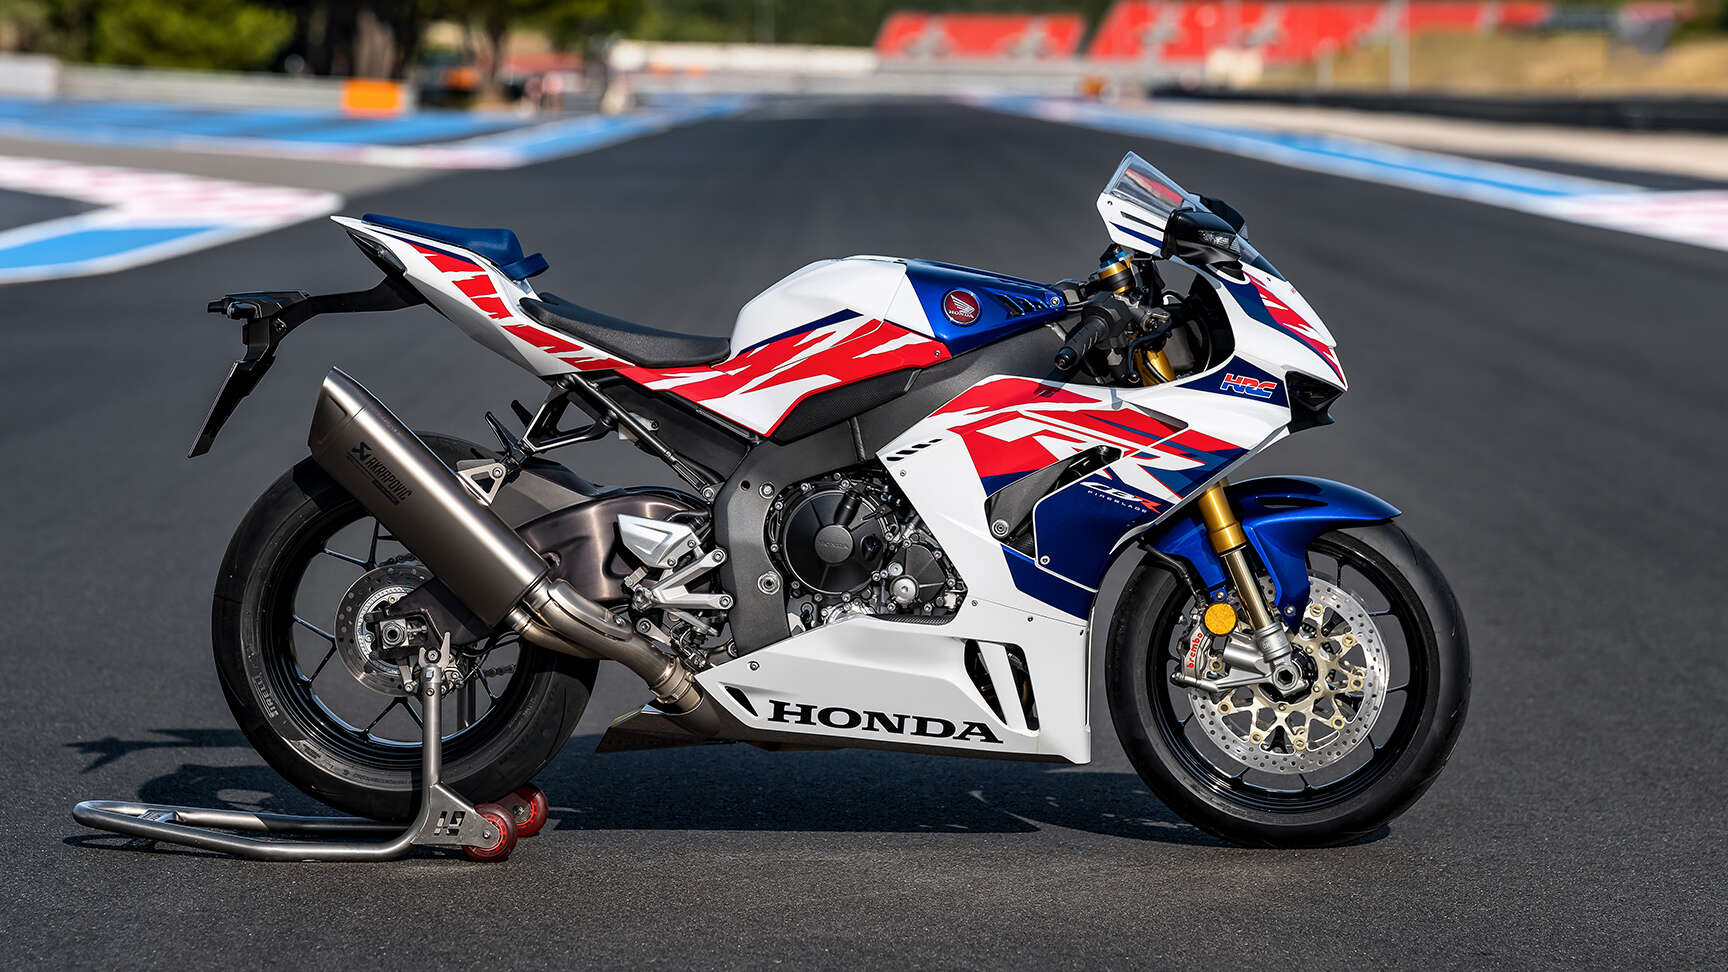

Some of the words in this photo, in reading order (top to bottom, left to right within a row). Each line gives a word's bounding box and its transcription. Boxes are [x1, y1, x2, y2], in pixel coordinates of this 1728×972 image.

[948, 310, 975, 319] HONDA
[1220, 373, 1277, 399] HRC
[1186, 632, 1203, 669] brembo
[767, 699, 1004, 744] HONDA
